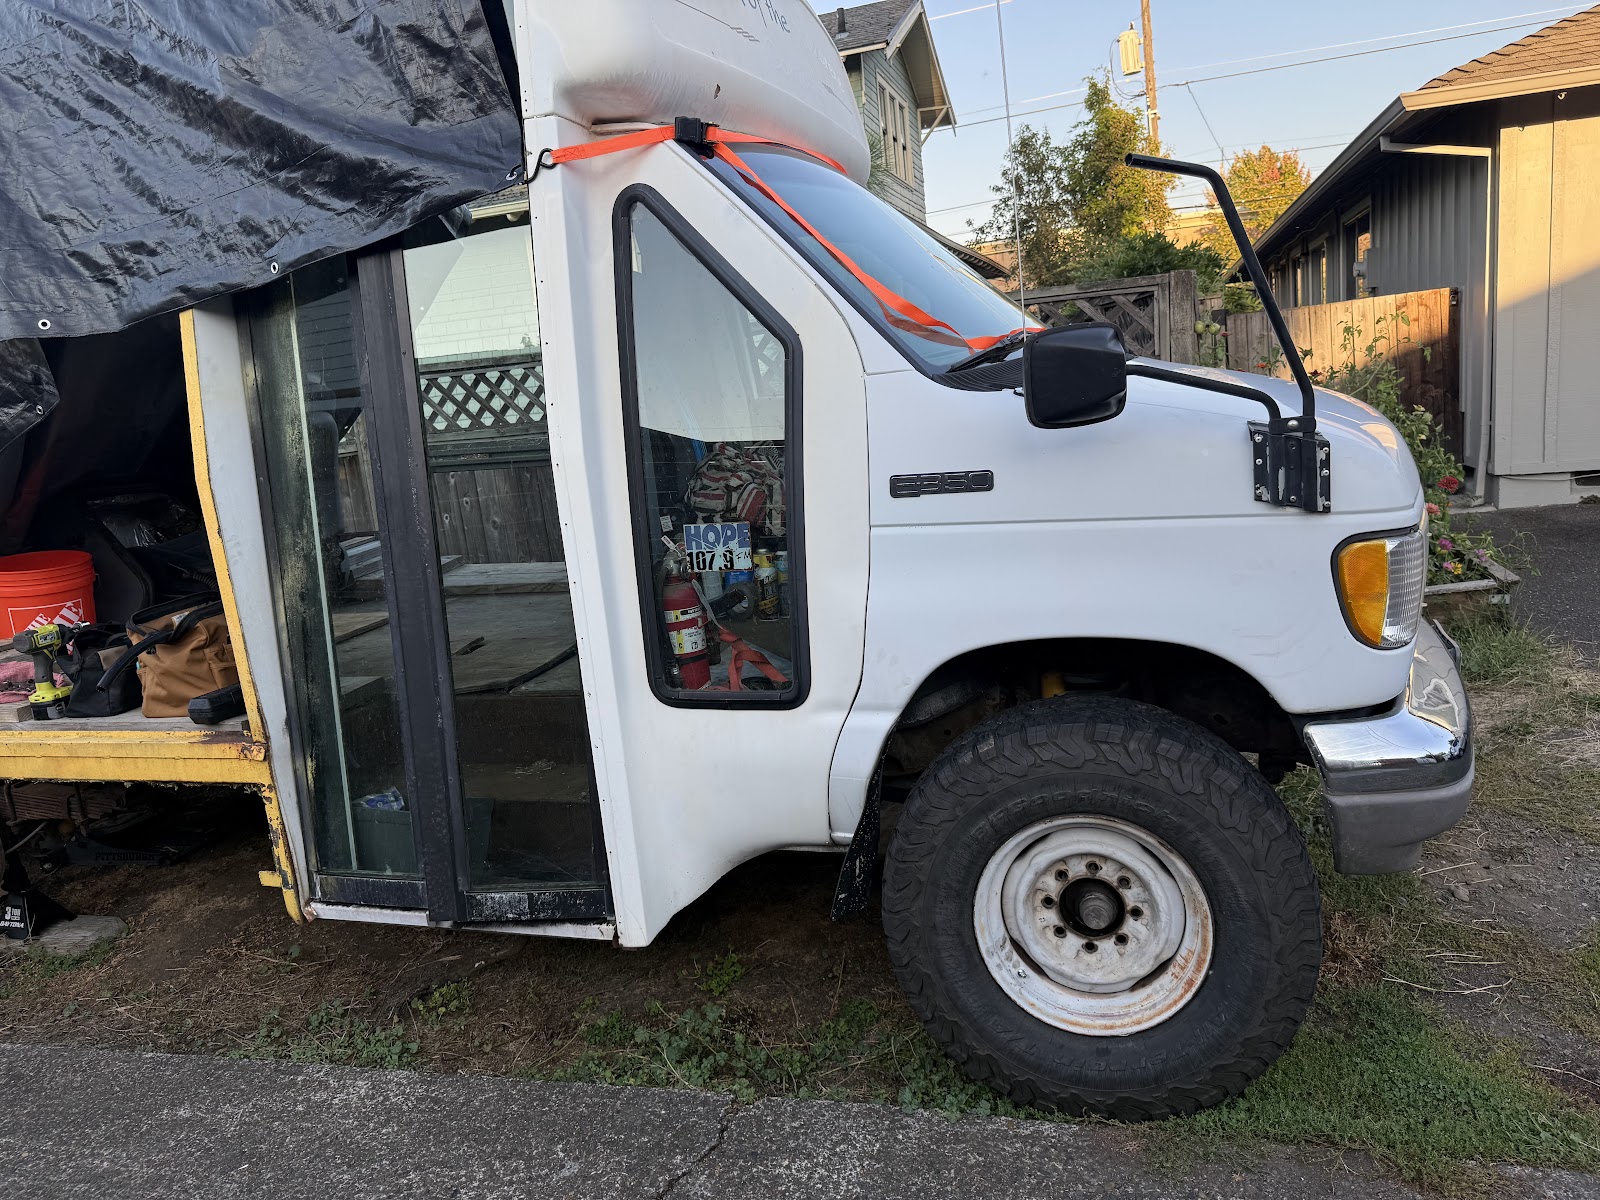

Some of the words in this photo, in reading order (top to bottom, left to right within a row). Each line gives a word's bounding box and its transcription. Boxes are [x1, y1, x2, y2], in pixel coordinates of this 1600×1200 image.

[684, 523, 750, 550] HOPE
[686, 550, 734, 571] 107.9
[95, 852, 155, 861] PITTSBURGH
[4, 906, 12, 920] 3
[11, 908, 21, 916] TON
